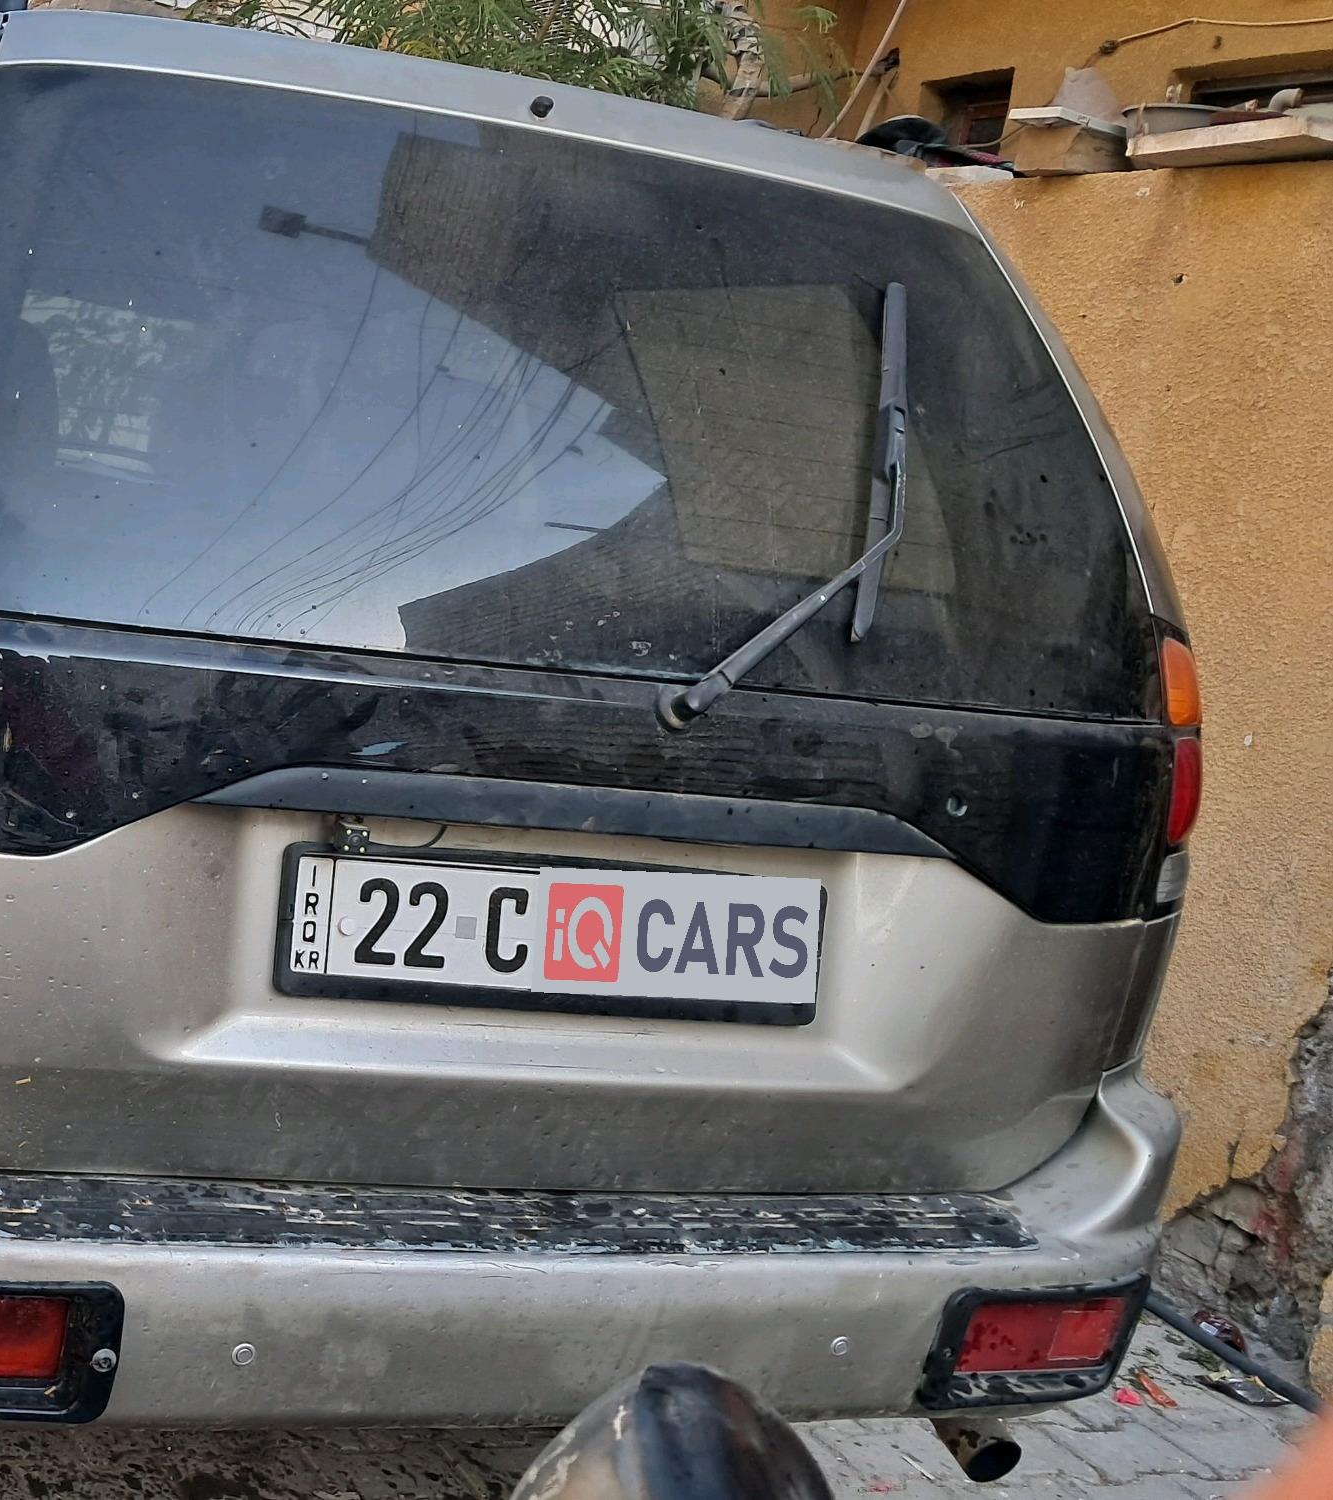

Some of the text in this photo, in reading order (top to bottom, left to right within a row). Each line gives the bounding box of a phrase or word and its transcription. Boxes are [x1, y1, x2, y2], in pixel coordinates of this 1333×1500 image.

[354, 878, 529, 973] 22 C
[294, 950, 320, 969] KR
